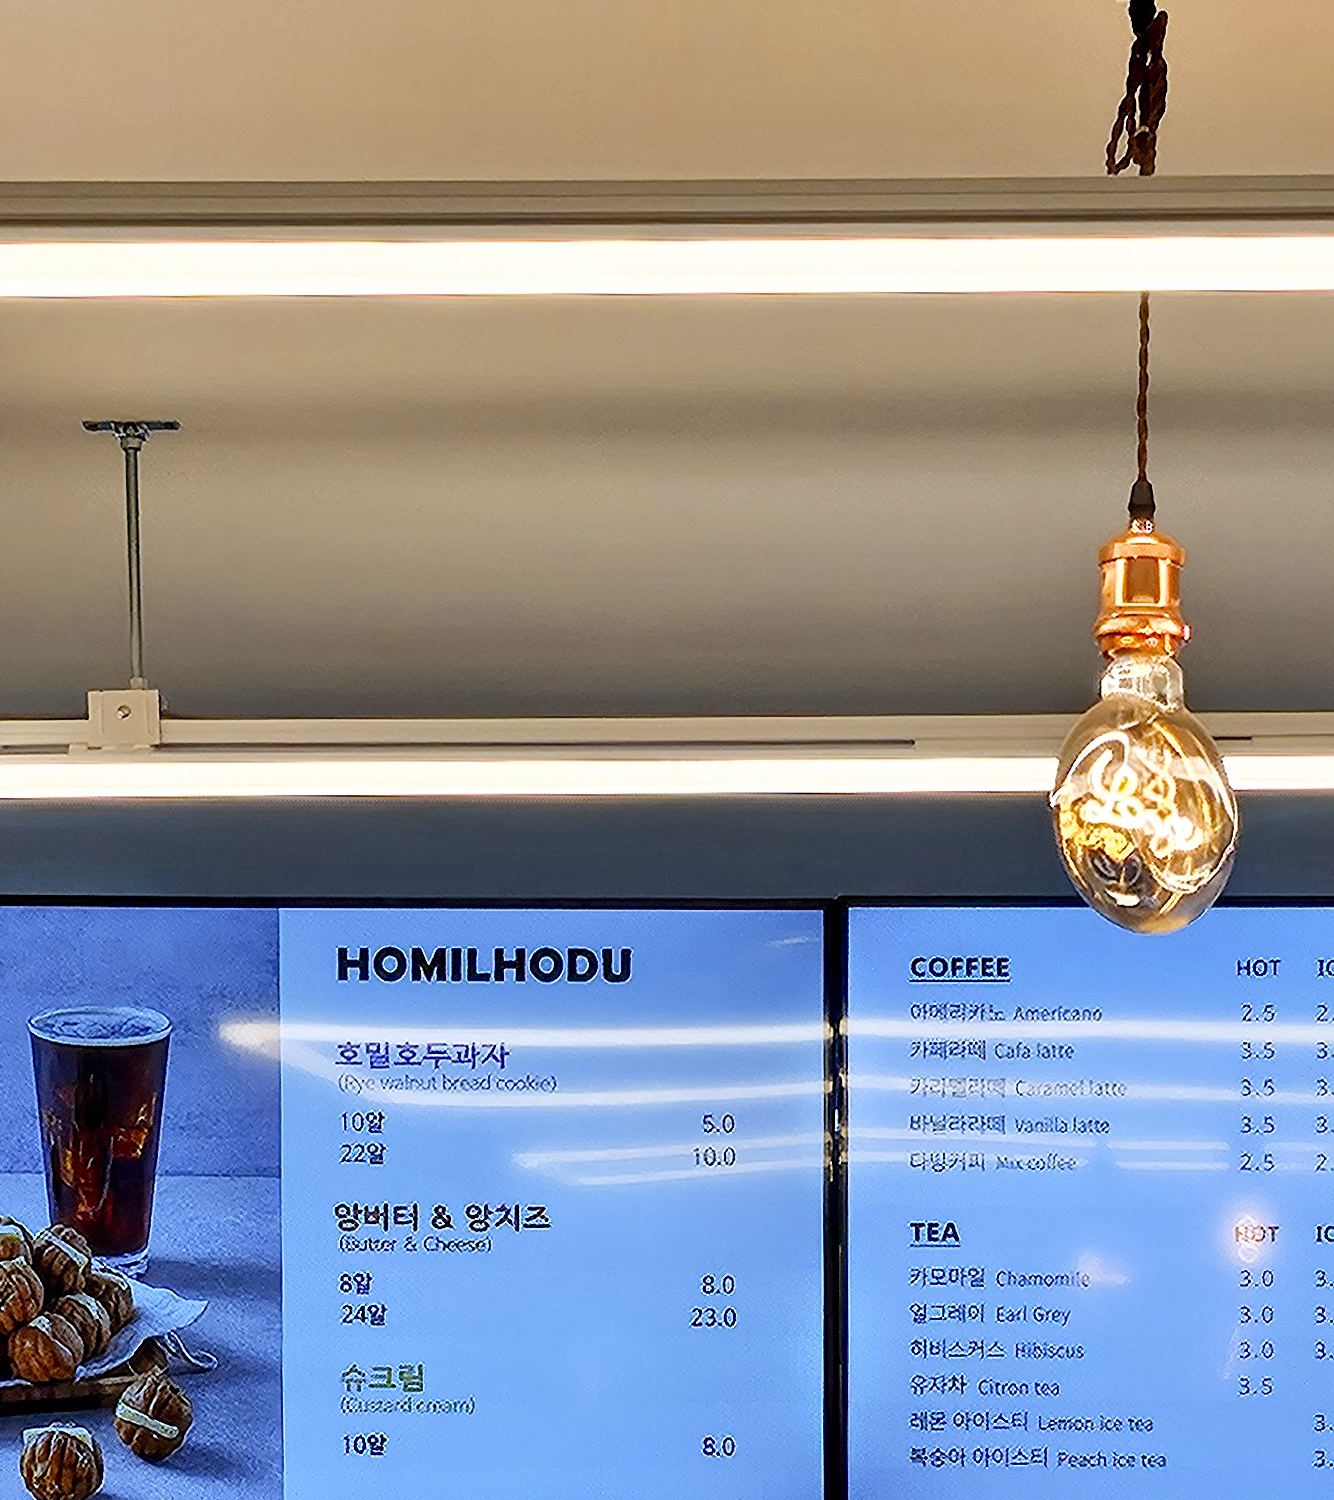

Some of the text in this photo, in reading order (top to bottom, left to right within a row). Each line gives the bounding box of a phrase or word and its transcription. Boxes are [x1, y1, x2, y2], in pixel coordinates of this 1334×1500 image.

[336, 947, 633, 983] HOMILHODU
[910, 957, 1010, 978] COFFEE
[1236, 960, 1280, 977] HOT
[910, 1003, 1005, 1022] 아메리카노
[1013, 1005, 1102, 1021] Americano
[1241, 1004, 1275, 1022] 2.5
[335, 1042, 510, 1071] 호밀호두과자
[1241, 1042, 1275, 1060] 3.5
[340, 1112, 735, 1134] 10알 5.0
[1241, 1117, 1275, 1134] 3.5
[340, 1143, 736, 1166] 22알 10.0
[1241, 1154, 1275, 1172] 2.5
[334, 1203, 551, 1232] 앙버터 & 앙치즈
[910, 1223, 960, 1243] TEA
[1235, 1226, 1280, 1243] HOT
[339, 1273, 735, 1295] 8알 8.0
[910, 1268, 985, 1288] 카모마일
[996, 1270, 1091, 1287] Chamomile
[1240, 1270, 1274, 1288] 3.0
[340, 1305, 737, 1327] 24알 23.0
[910, 1305, 984, 1324] 얼그레이
[996, 1306, 1028, 1323] Earl
[1033, 1306, 1071, 1326] Grey
[1240, 1306, 1274, 1324] 3.0
[910, 1341, 1005, 1360] 히비스커스
[1240, 1342, 1274, 1360] 3.0
[341, 1364, 425, 1393] 슈크림
[911, 1375, 1273, 1396] 유자차 Citron tea 3.5
[910, 1412, 946, 1431] 레몬
[953, 1412, 1028, 1431] 아이스티
[1038, 1415, 1094, 1432] Lemon
[1099, 1415, 1123, 1432] ice
[1128, 1417, 1153, 1432] tea
[342, 1435, 736, 1457] 10알 8.0
[910, 1448, 965, 1468] 복숭아
[972, 1448, 1048, 1468] 아이스티
[1057, 1451, 1107, 1468] Peach
[1113, 1451, 1136, 1468] ice
[1141, 1453, 1167, 1468] tea
